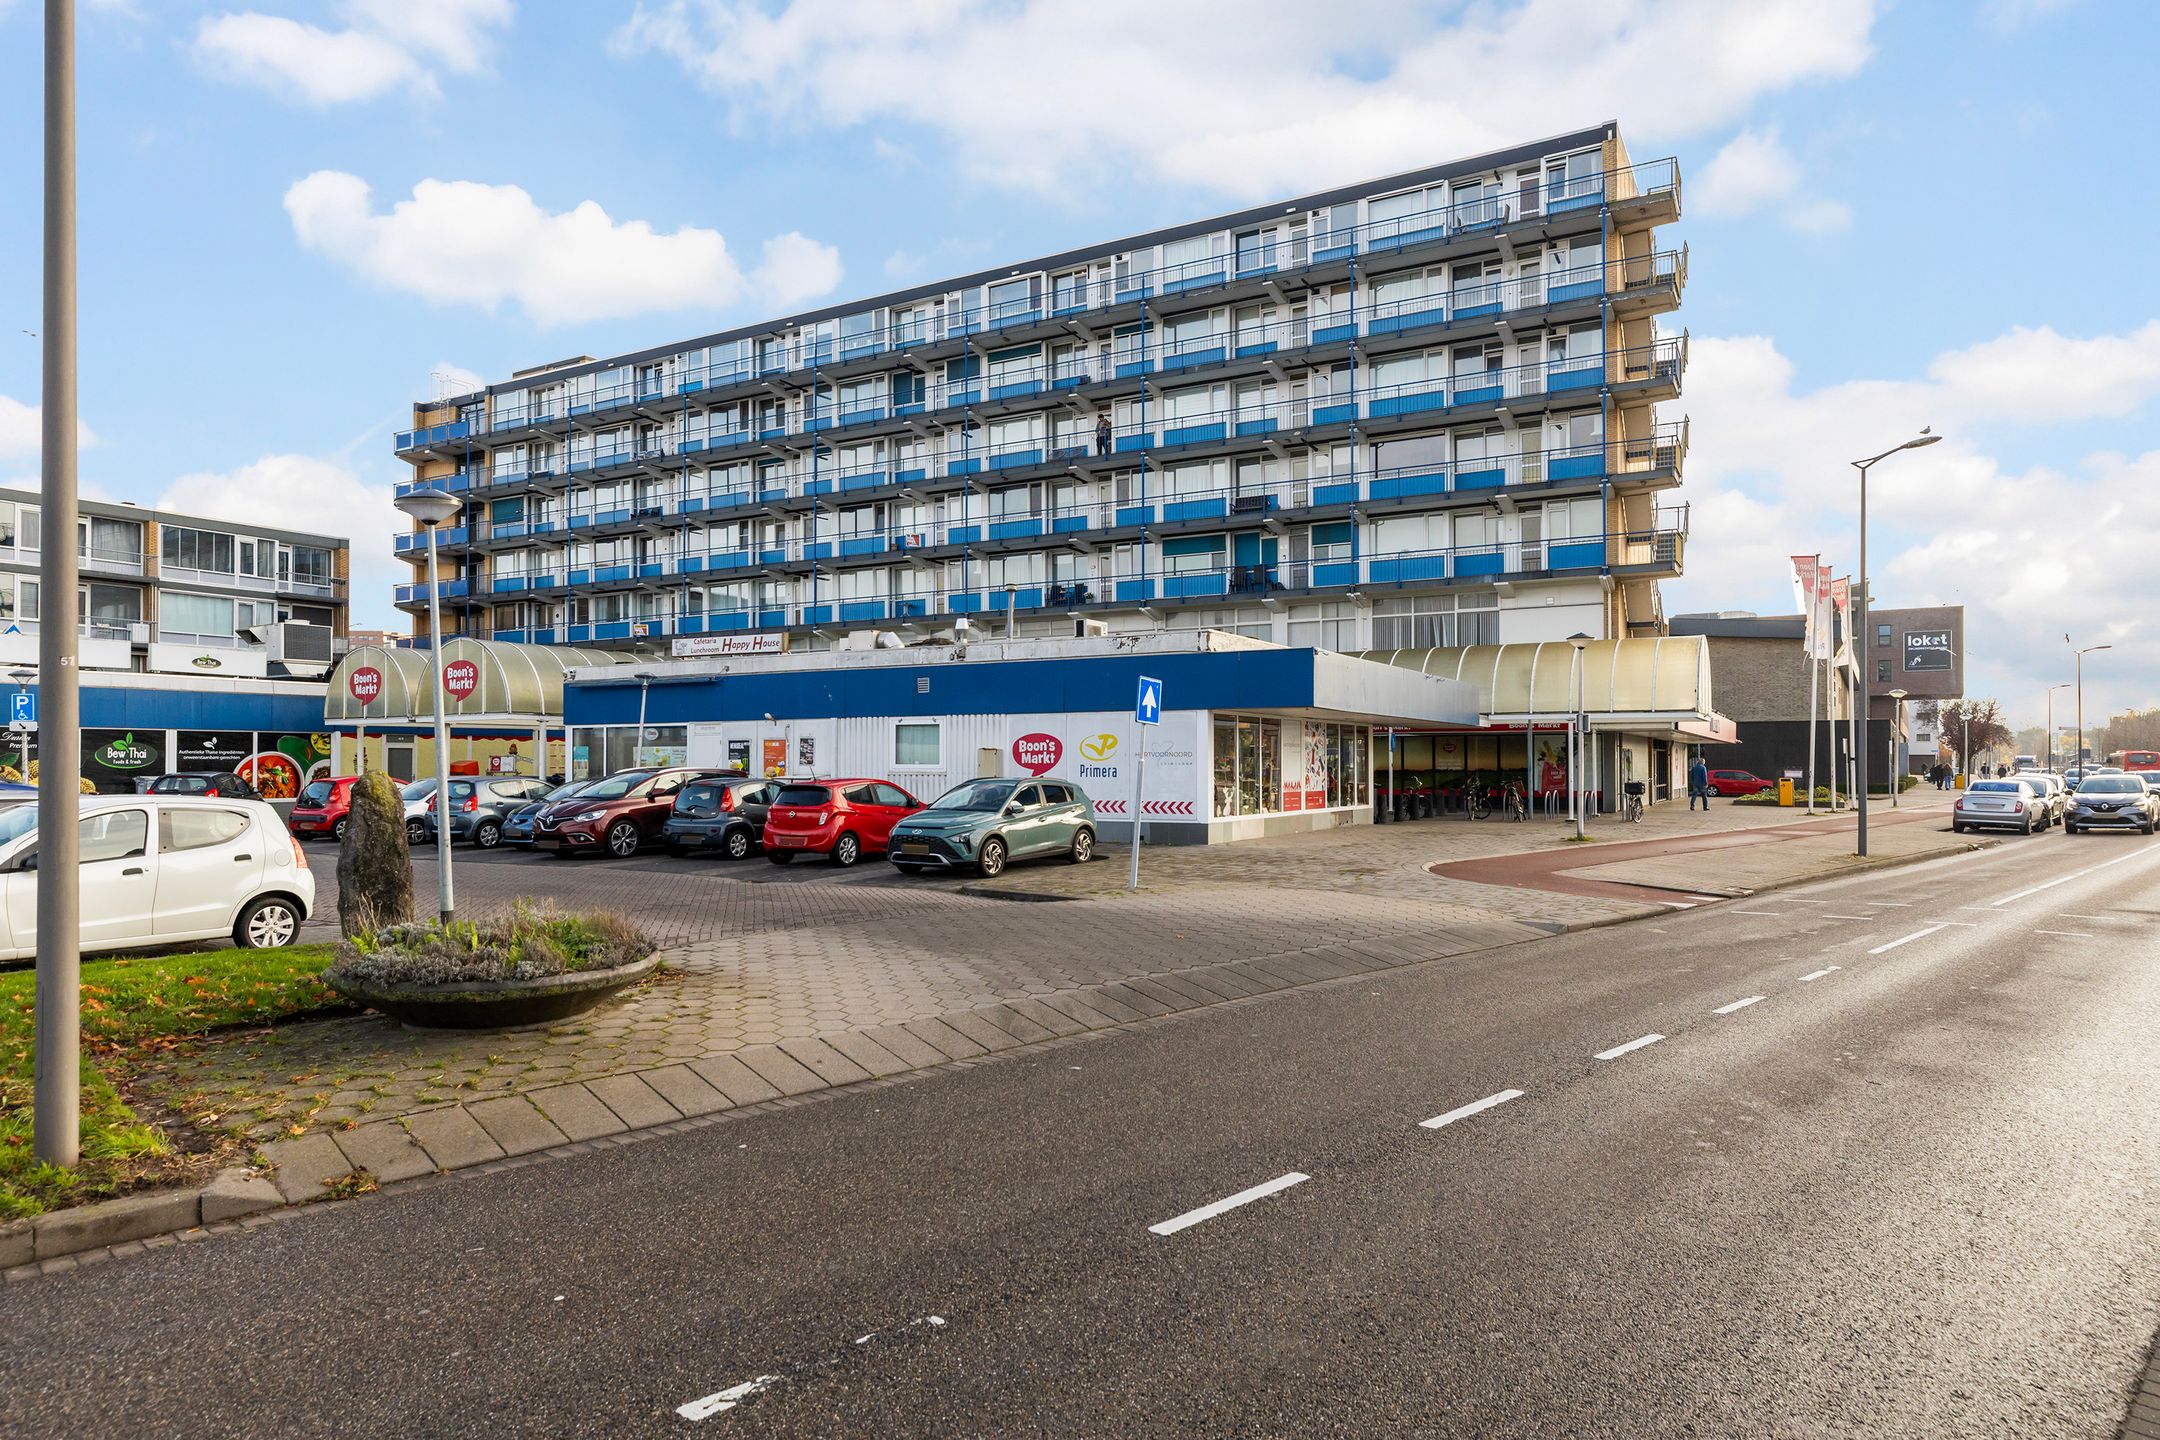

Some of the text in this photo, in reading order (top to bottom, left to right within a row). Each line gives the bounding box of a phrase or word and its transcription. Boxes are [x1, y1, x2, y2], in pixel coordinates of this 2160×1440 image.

[722, 636, 780, 652] Happy House
[1907, 634, 1947, 646] loket
[353, 672, 378, 684] Boon's
[447, 666, 474, 679] Boon's
[355, 684, 378, 695] Markt
[449, 678, 474, 690] Markt
[16, 696, 29, 710] P
[1018, 739, 1056, 752] Boon's
[107, 747, 147, 759] Bew Thai
[1021, 752, 1056, 764] Markt
[1080, 764, 1118, 778] Primera
